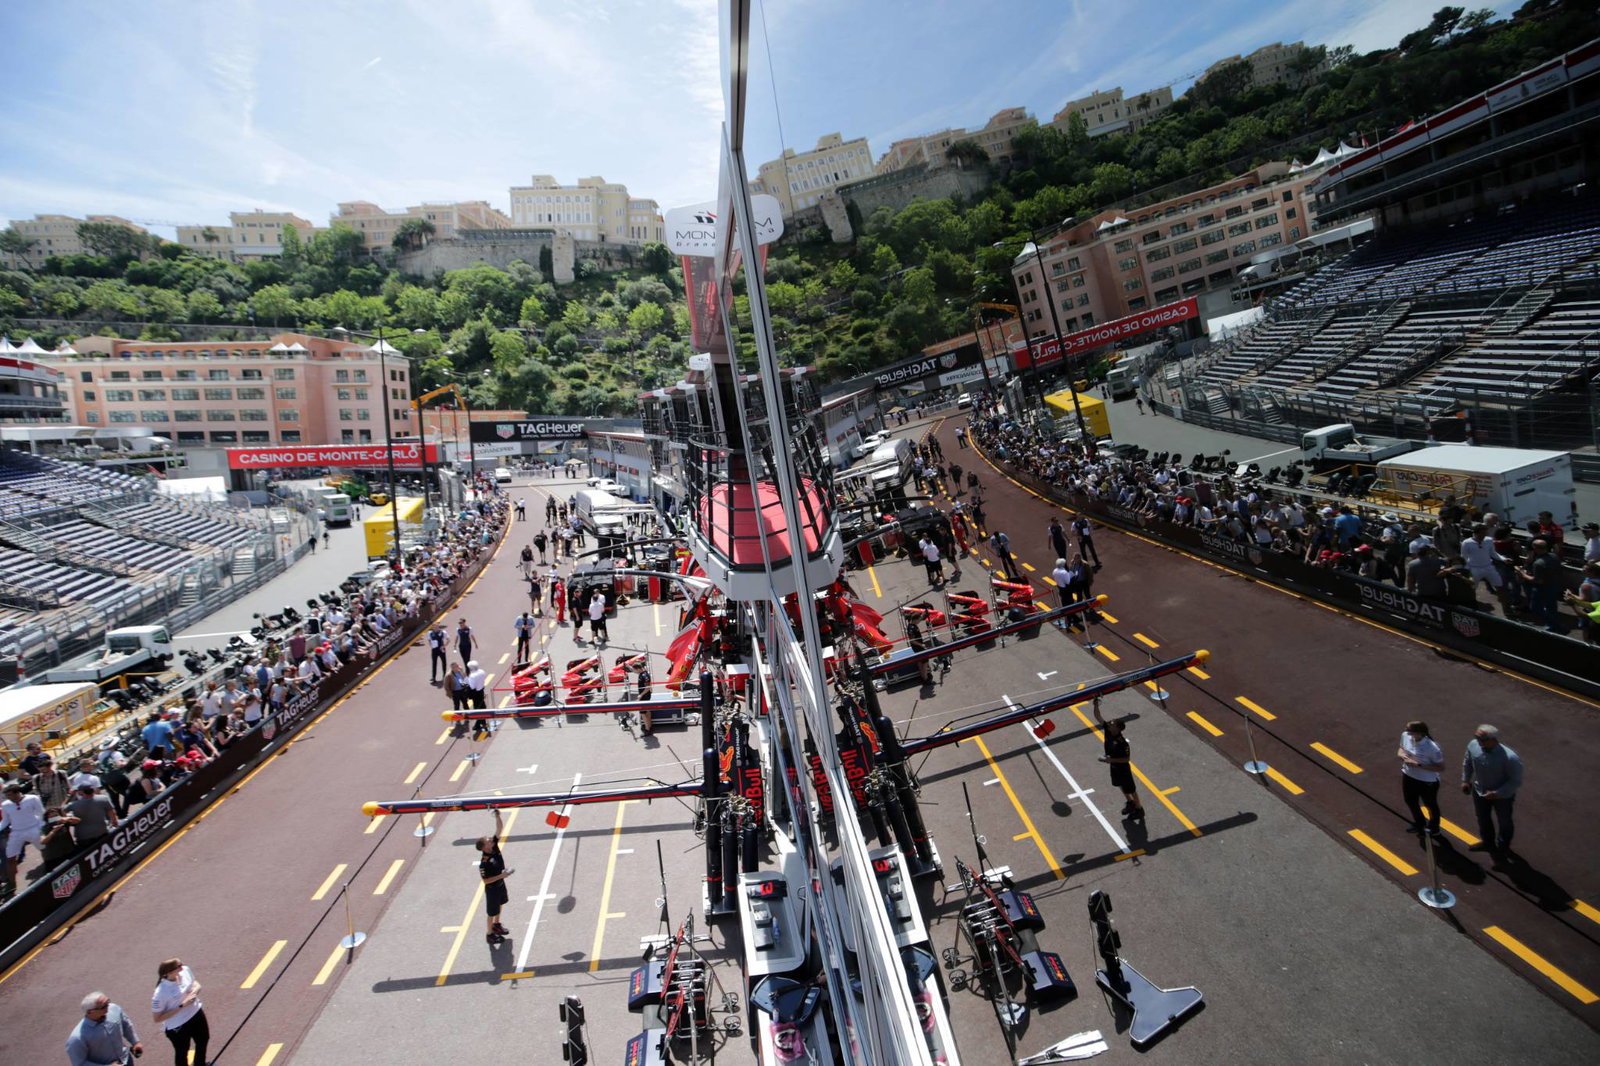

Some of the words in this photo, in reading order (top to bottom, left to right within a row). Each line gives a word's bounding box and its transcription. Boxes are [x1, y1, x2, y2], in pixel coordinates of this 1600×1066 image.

[676, 230, 716, 240] MON
[239, 452, 295, 464] CASINO
[297, 453, 317, 462] DE
[319, 449, 419, 462] MONTE-CARLO
[745, 768, 762, 798] Bull
